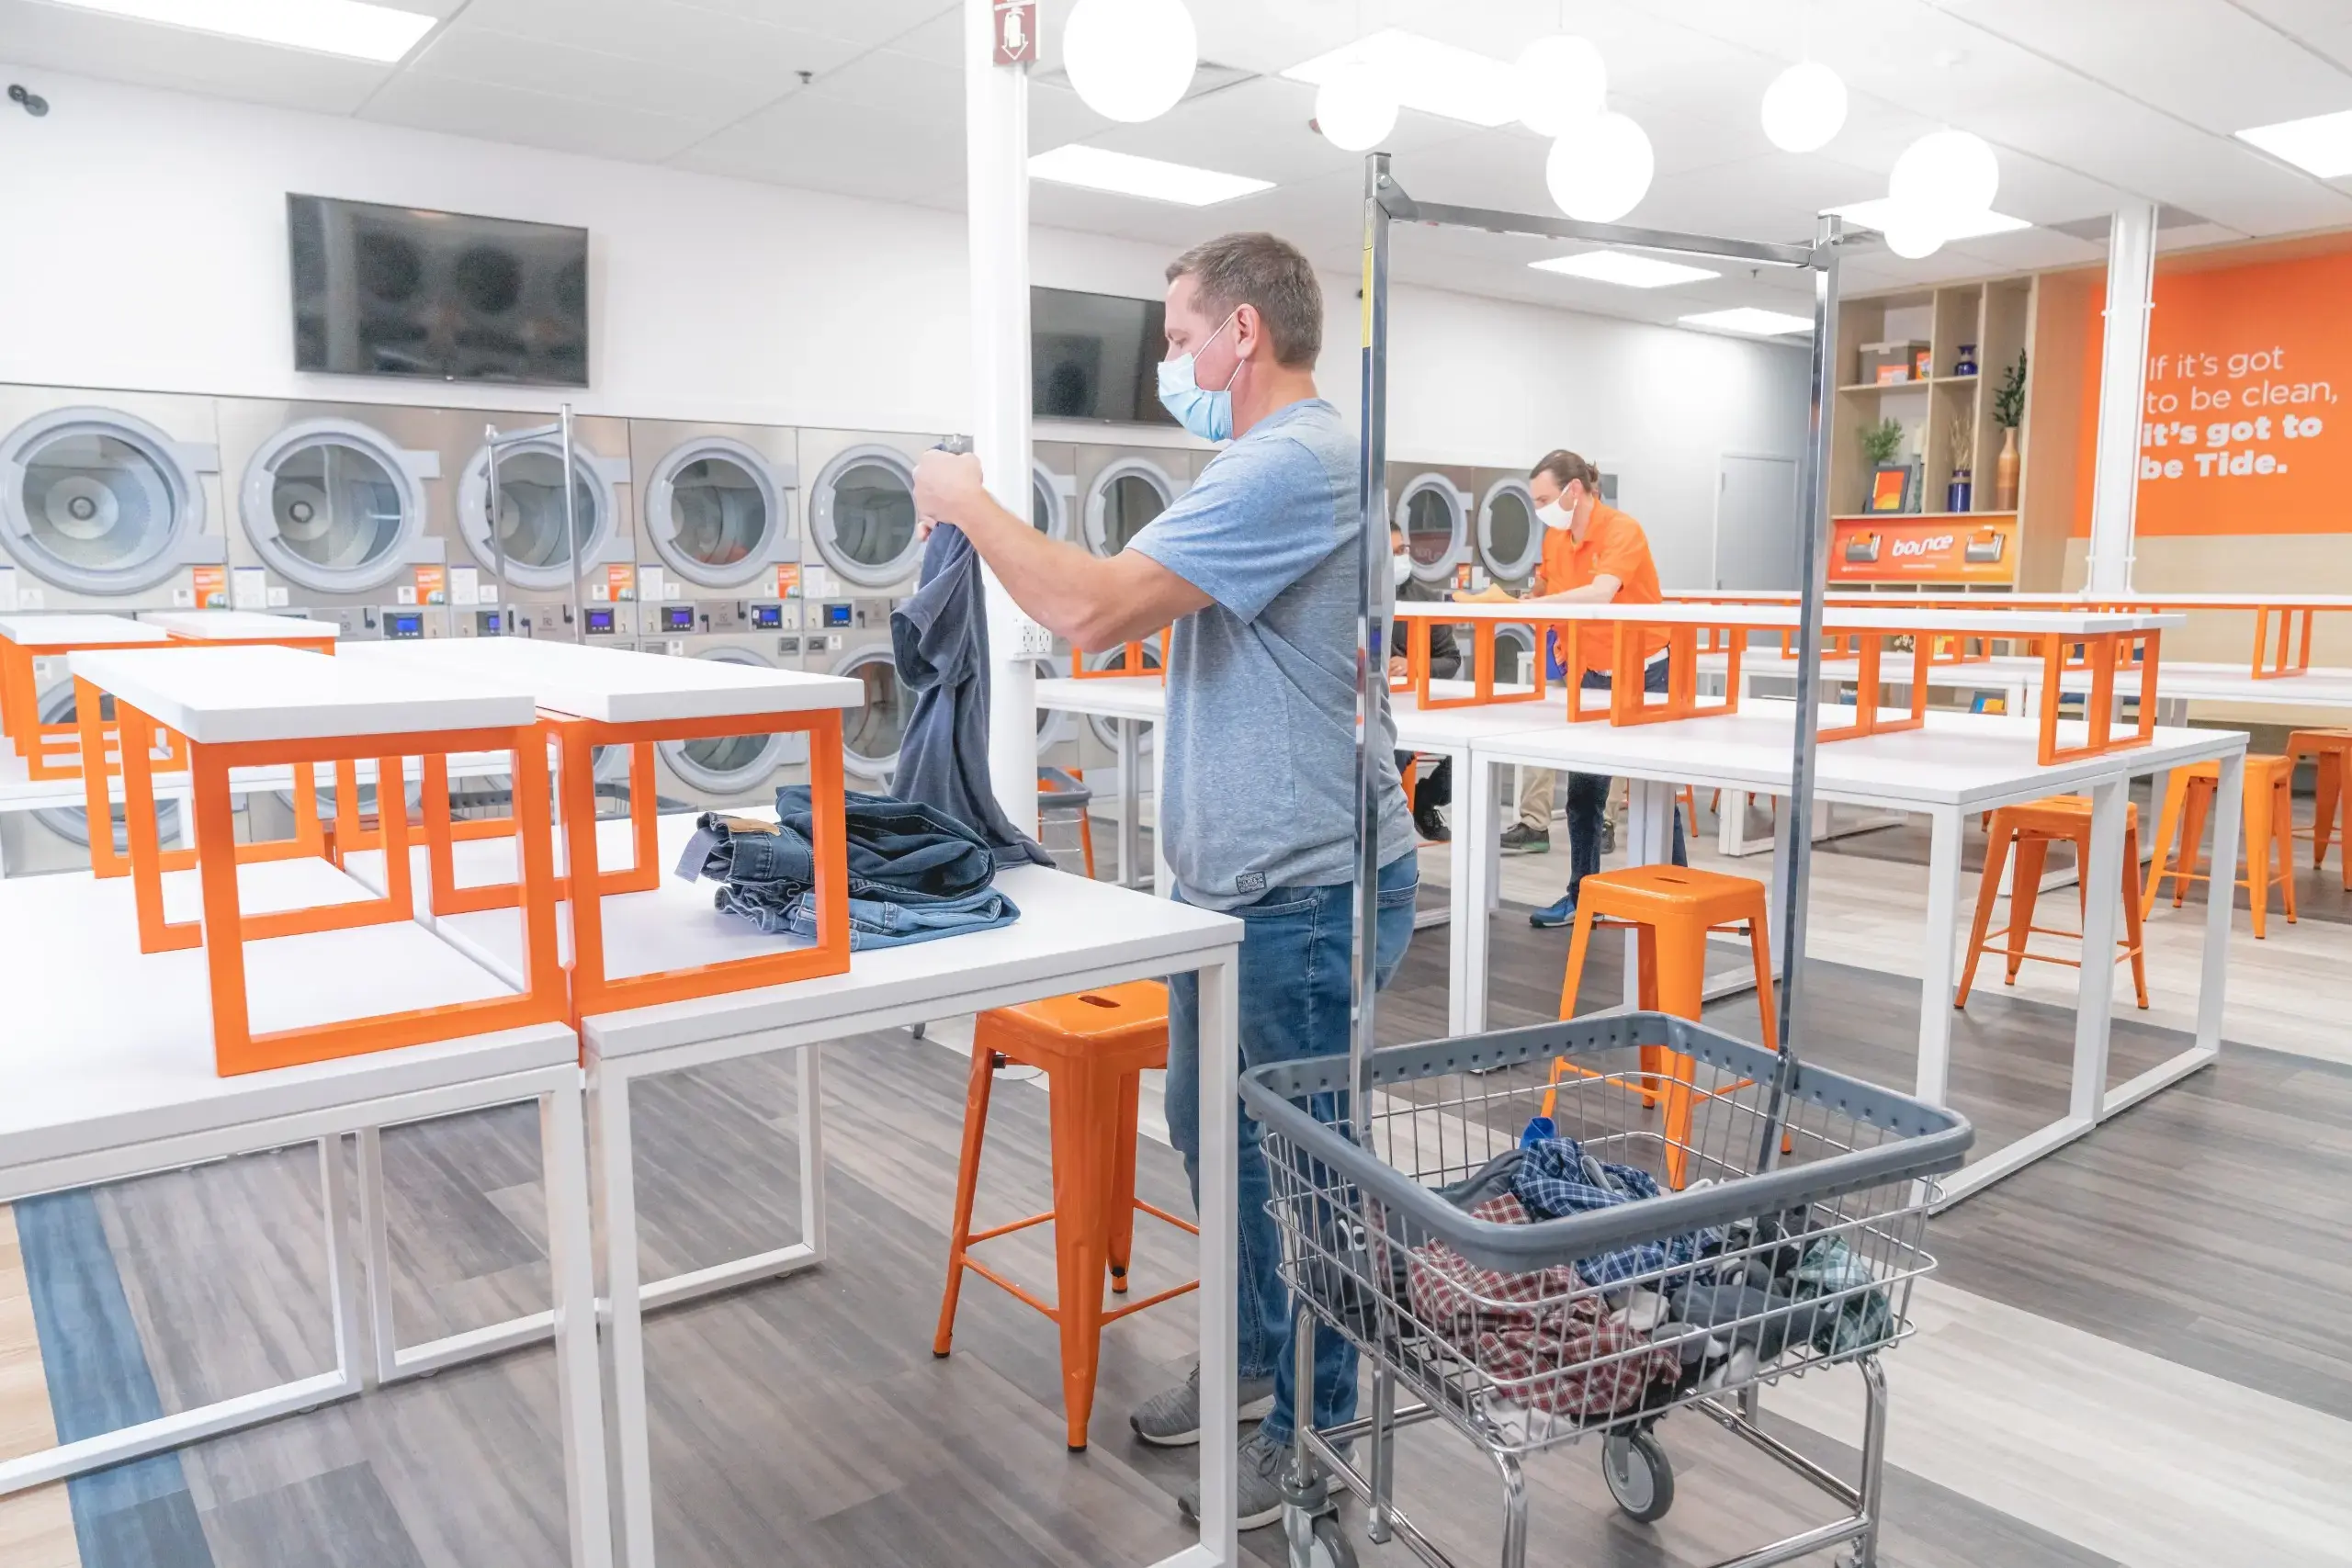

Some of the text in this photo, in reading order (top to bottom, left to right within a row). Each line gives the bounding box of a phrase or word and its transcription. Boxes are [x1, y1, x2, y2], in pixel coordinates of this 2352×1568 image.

[2149, 345, 2285, 381] If it's got
[2146, 379, 2338, 414] to be clean,
[2142, 413, 2323, 448] it's got to
[2140, 449, 2288, 479] be Tide.
